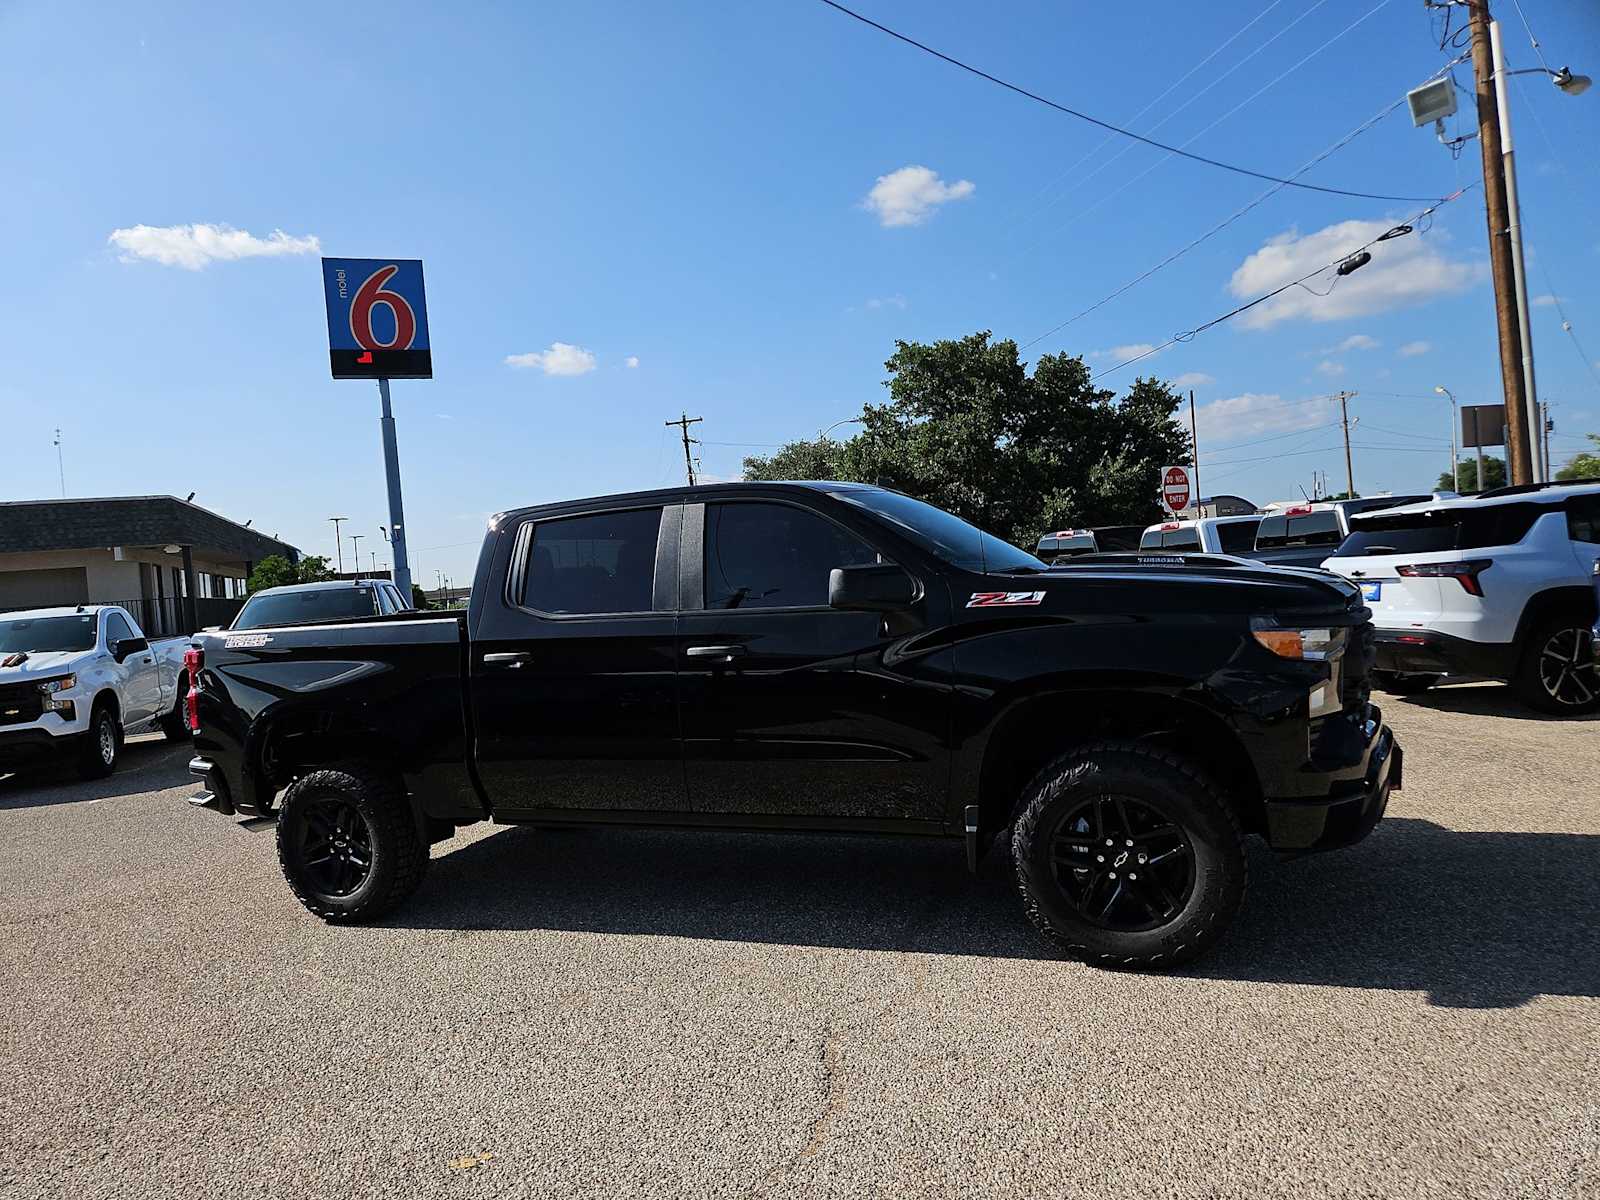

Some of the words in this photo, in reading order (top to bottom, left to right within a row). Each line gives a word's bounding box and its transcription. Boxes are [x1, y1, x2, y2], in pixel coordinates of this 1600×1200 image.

[335, 269, 348, 299] motel
[349, 264, 416, 350] 6
[1166, 475, 1173, 484] DO
[1175, 474, 1185, 483] NOT
[1169, 494, 1185, 503] ENTER
[965, 591, 1047, 608] Z71
